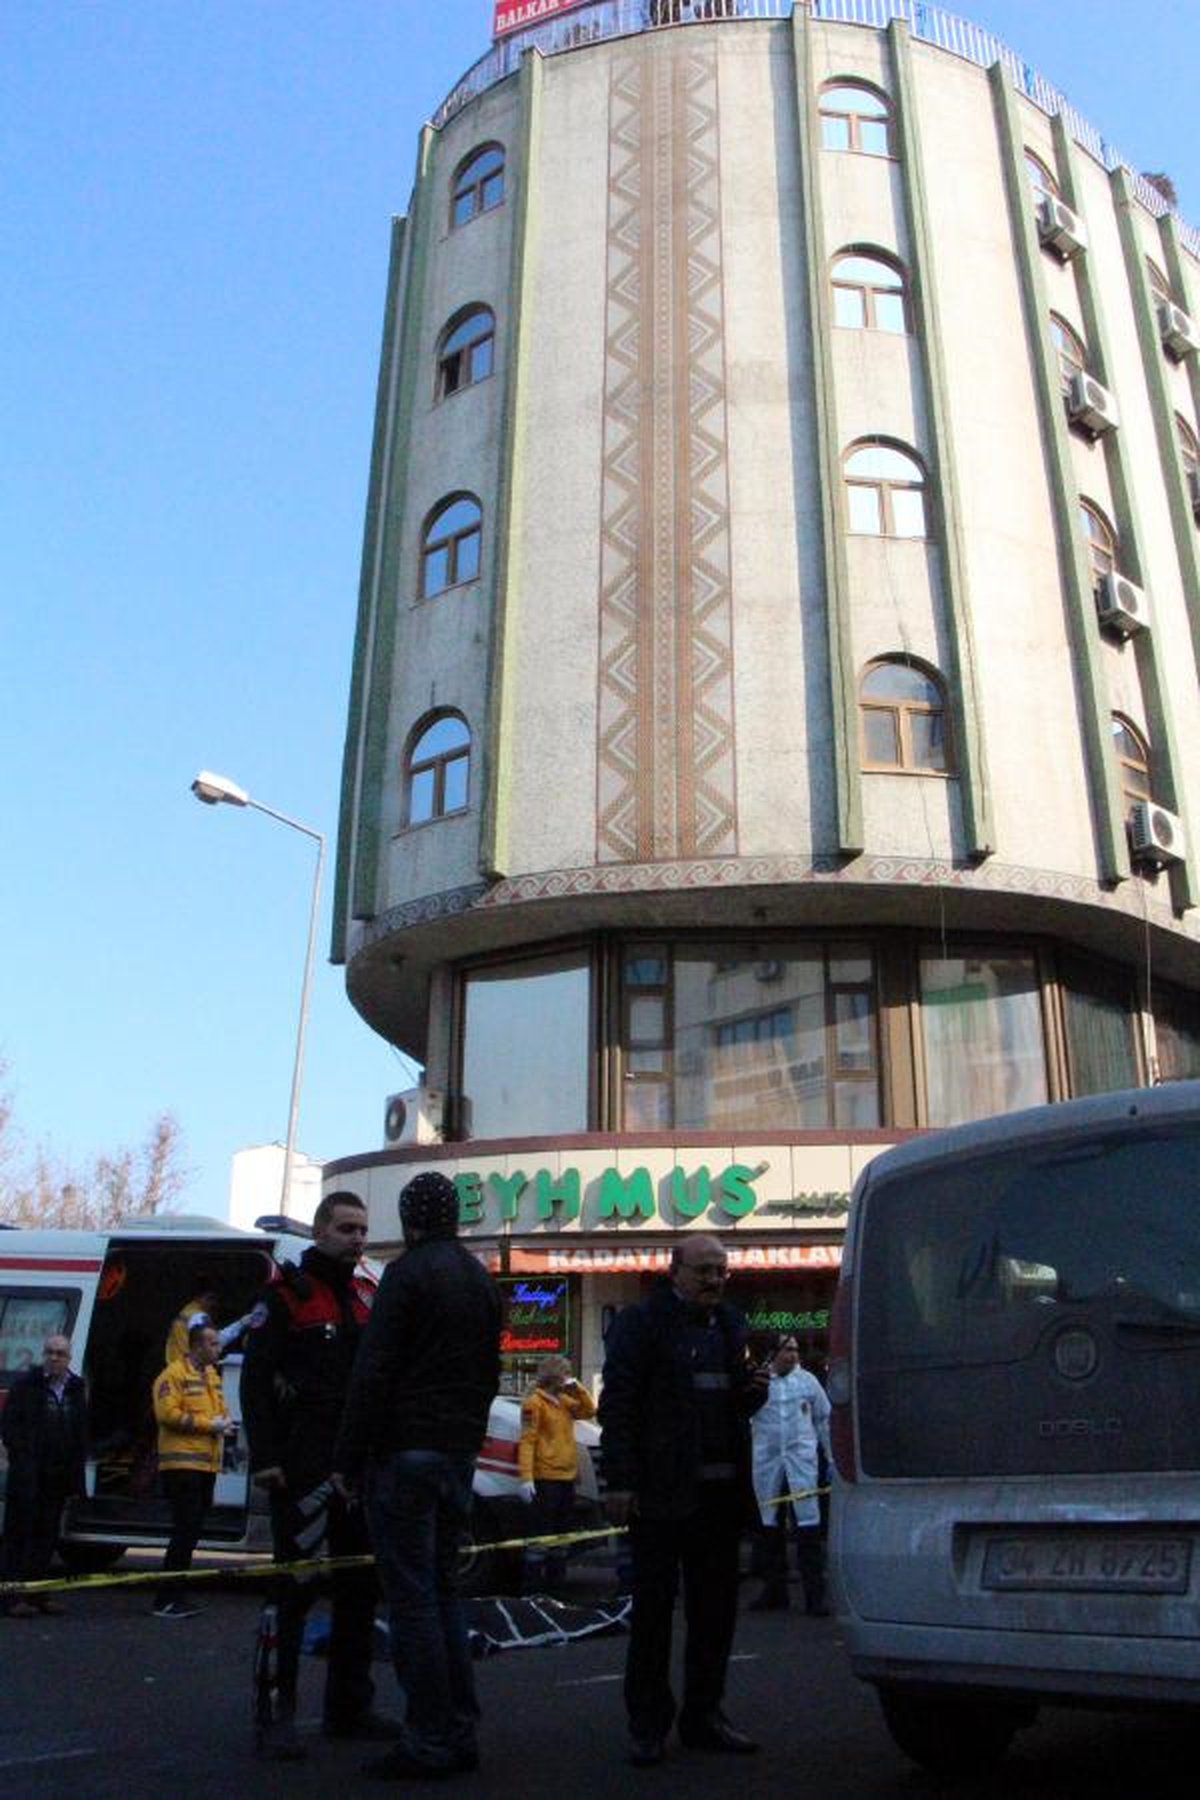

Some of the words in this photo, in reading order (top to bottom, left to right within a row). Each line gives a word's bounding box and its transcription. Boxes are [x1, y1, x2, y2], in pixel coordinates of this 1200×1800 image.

[454, 1162, 769, 1224] EYHMUS
[546, 1247, 673, 1270] KADAYI
[726, 1245, 843, 1267] BAKLAV
